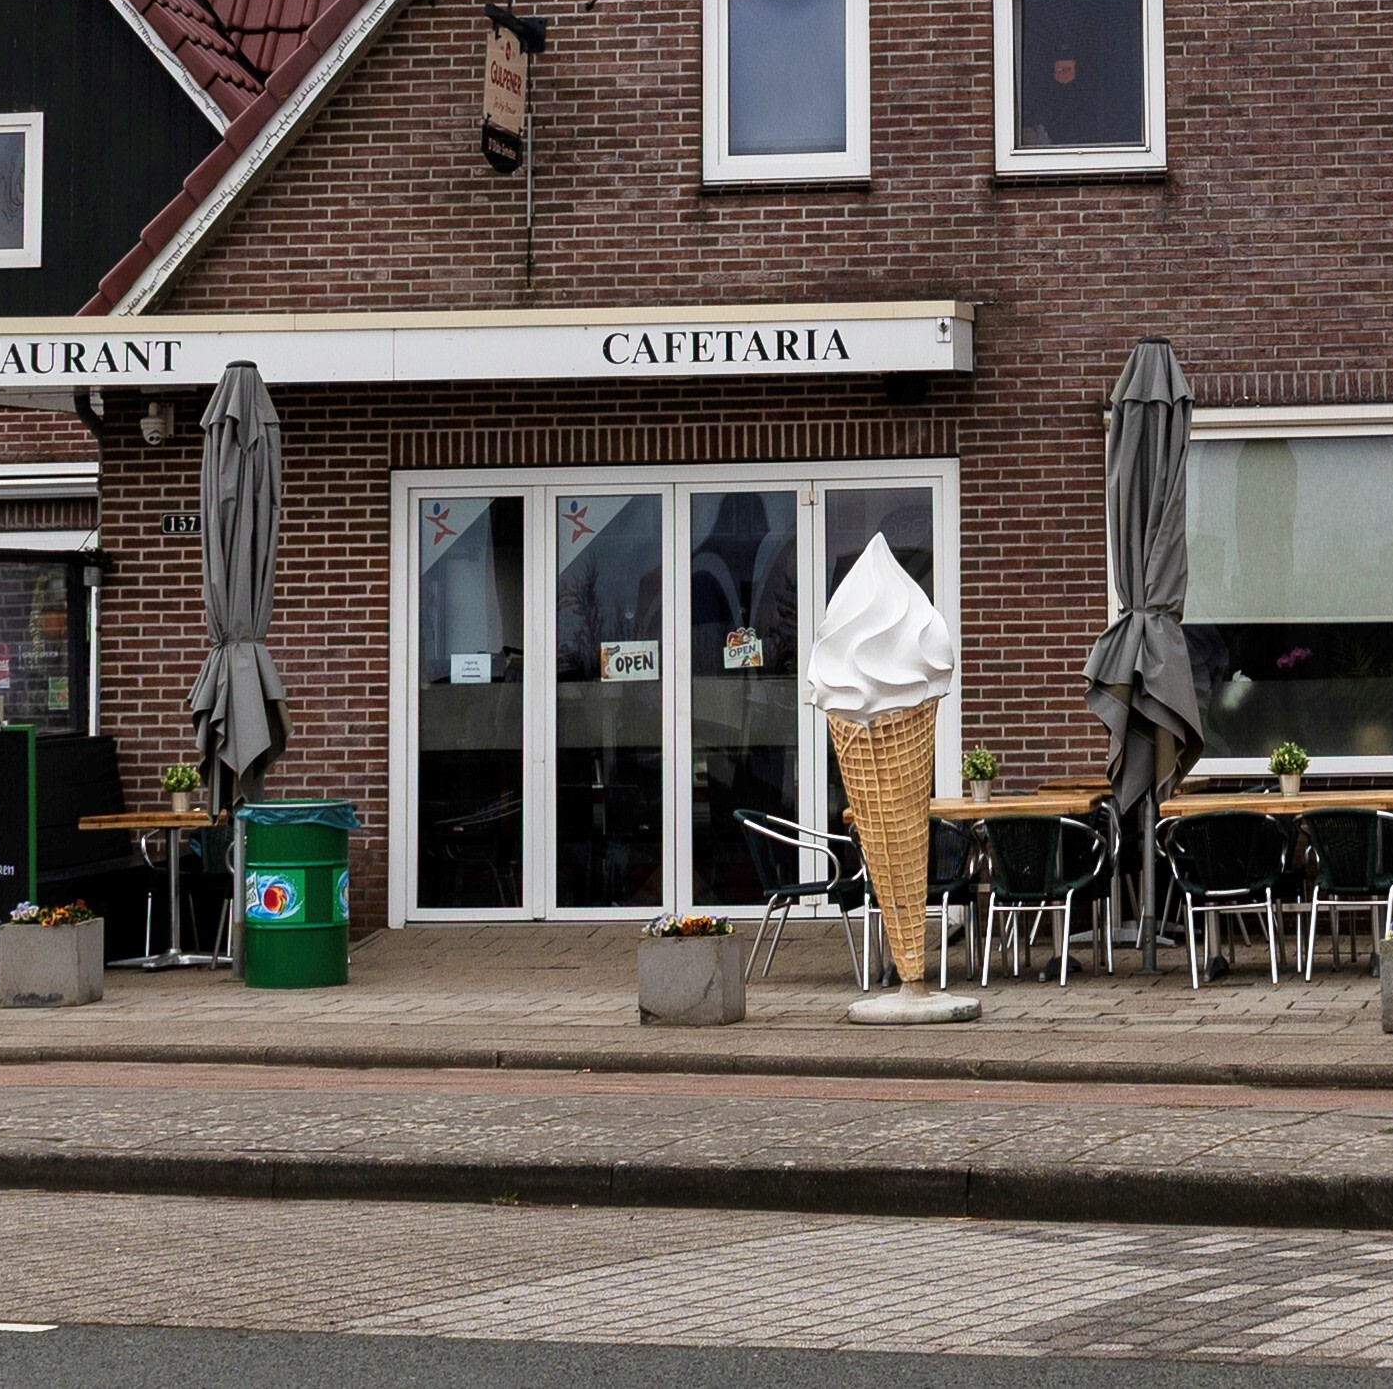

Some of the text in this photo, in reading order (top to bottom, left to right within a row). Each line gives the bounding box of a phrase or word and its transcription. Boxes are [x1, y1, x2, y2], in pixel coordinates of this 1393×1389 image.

[601, 328, 851, 365] CAFETARIA
[170, 516, 196, 531] 157
[729, 643, 756, 658] OPEN
[615, 650, 654, 675] OPEN
